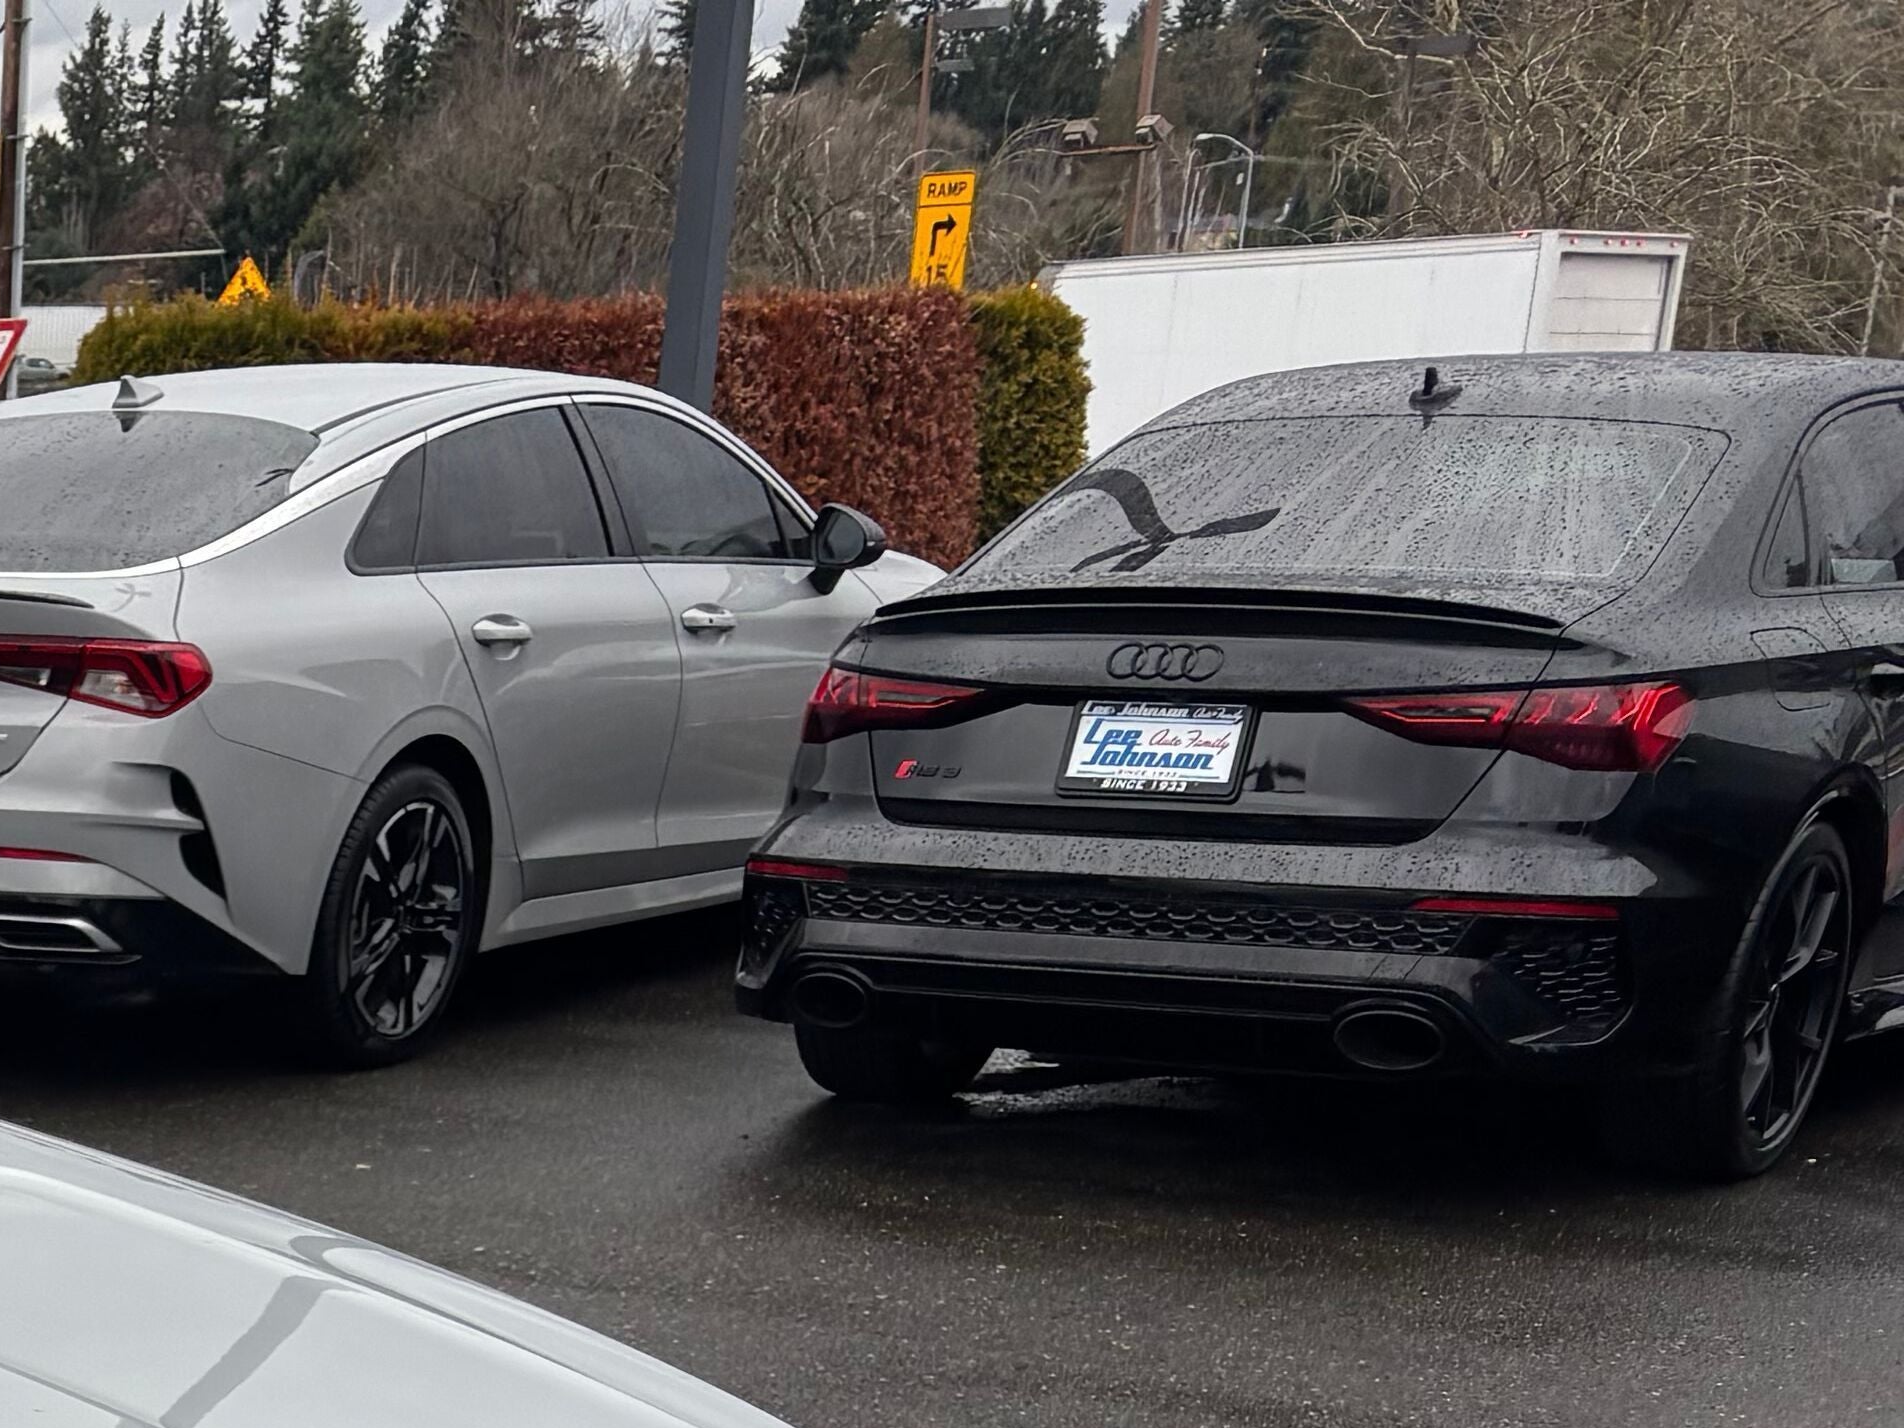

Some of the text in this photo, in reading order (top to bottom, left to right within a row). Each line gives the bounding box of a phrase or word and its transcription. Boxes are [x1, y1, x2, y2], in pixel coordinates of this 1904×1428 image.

[927, 181, 968, 198] RAMP
[1081, 700, 1112, 715] Lee
[1117, 702, 1190, 718] Johnson
[1083, 718, 1232, 755] Lee Auto Family
[1080, 740, 1214, 770] Johnson
[1100, 779, 1188, 792] SINCE 1933
